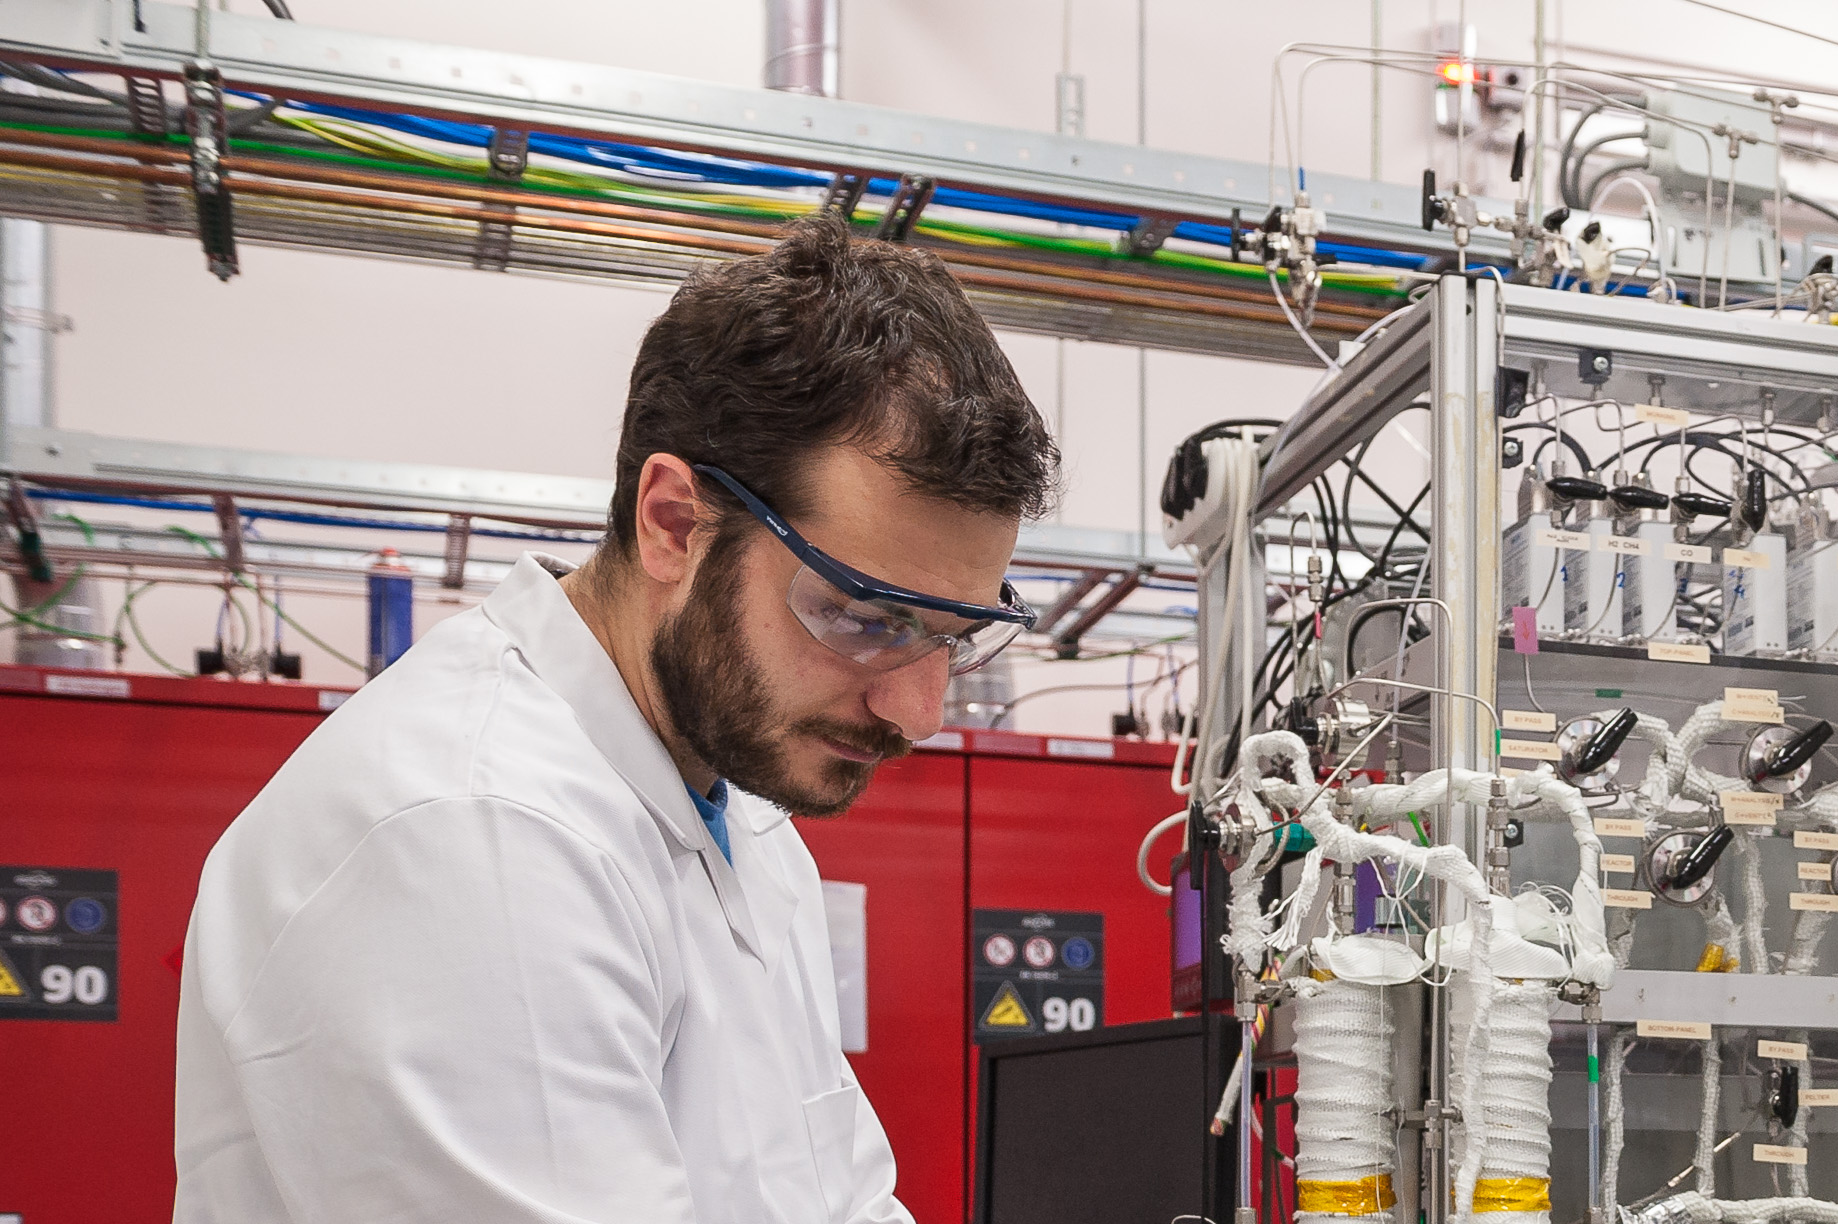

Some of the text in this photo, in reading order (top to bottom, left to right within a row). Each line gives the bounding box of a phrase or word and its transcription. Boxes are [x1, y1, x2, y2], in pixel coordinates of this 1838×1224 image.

[1561, 565, 1569, 582] 1
[1616, 572, 1625, 588] 2
[40, 964, 108, 1005] 90
[1043, 996, 1096, 1033] 90
